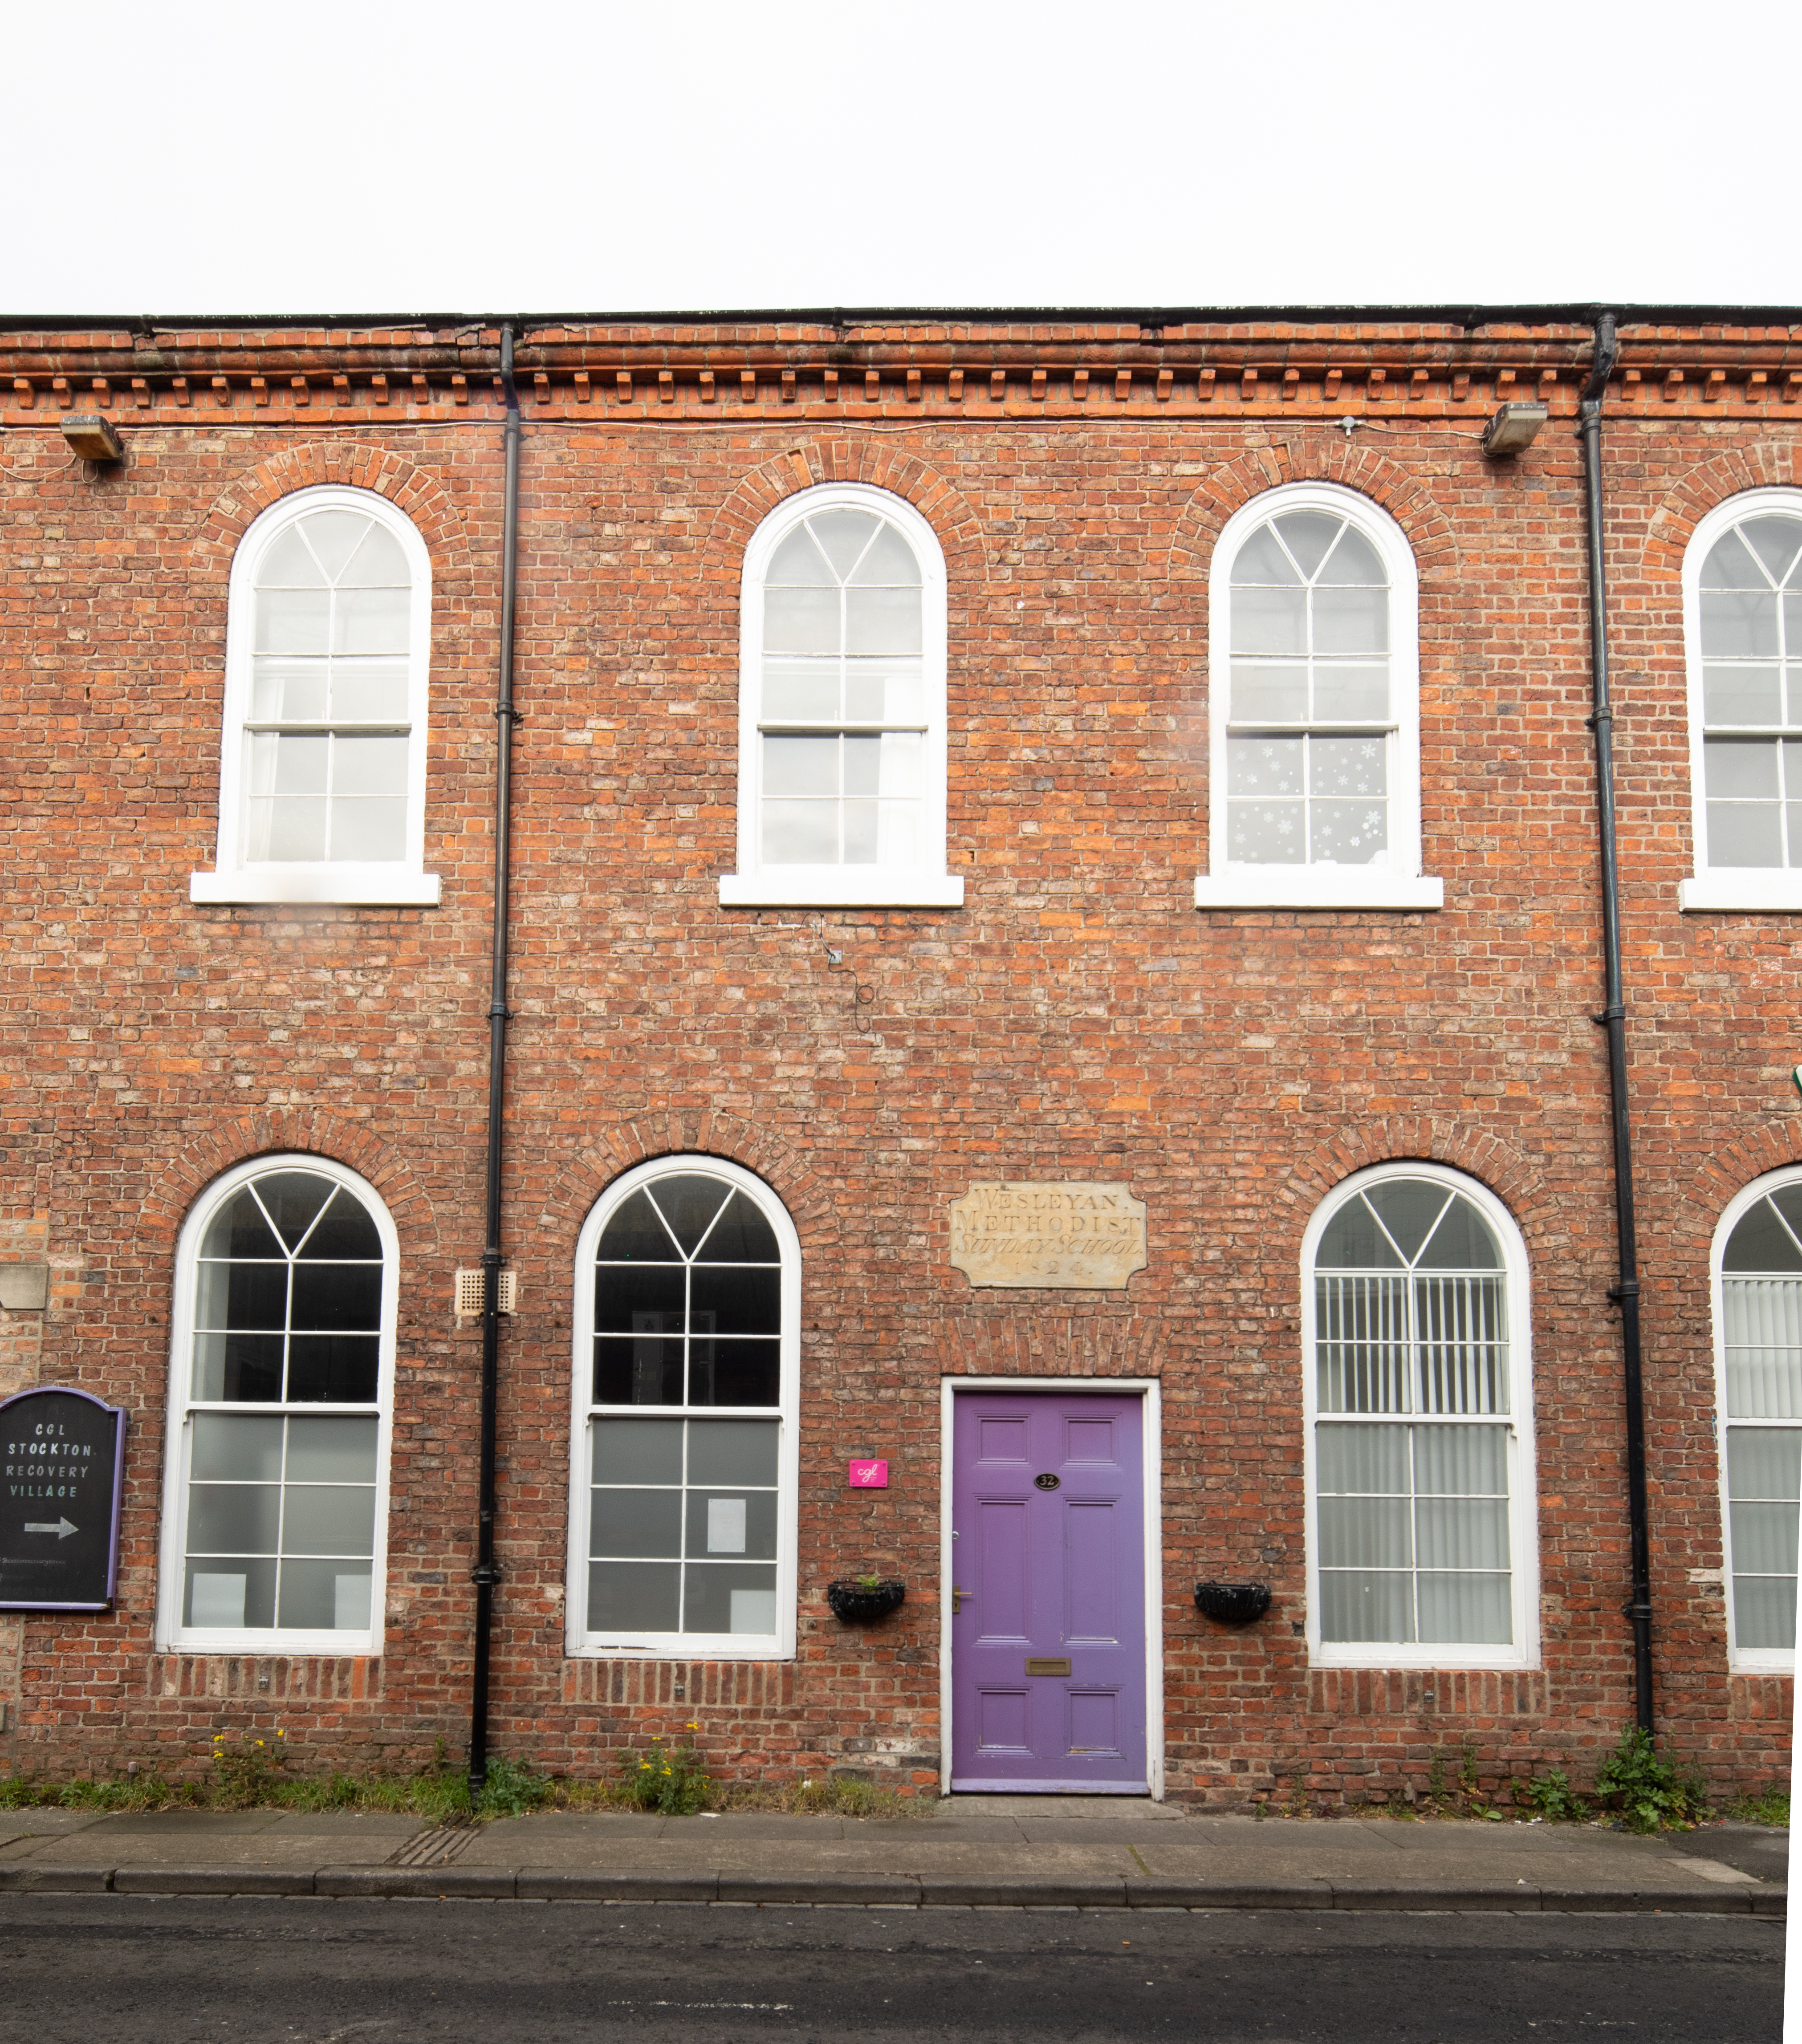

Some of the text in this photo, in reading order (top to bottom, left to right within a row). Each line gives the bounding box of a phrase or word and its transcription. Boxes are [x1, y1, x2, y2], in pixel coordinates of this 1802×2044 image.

[955, 1210, 1140, 1233] METHODIST
[955, 1234, 1053, 1254] SUNDAY
[36, 1424, 65, 1435] CGL
[8, 1443, 91, 1456] STOCKTON
[6, 1465, 89, 1478] RECOVERY
[858, 1464, 878, 1483] cgl
[1040, 1476, 1054, 1485] 32
[10, 1485, 77, 1497] VILLAGE
